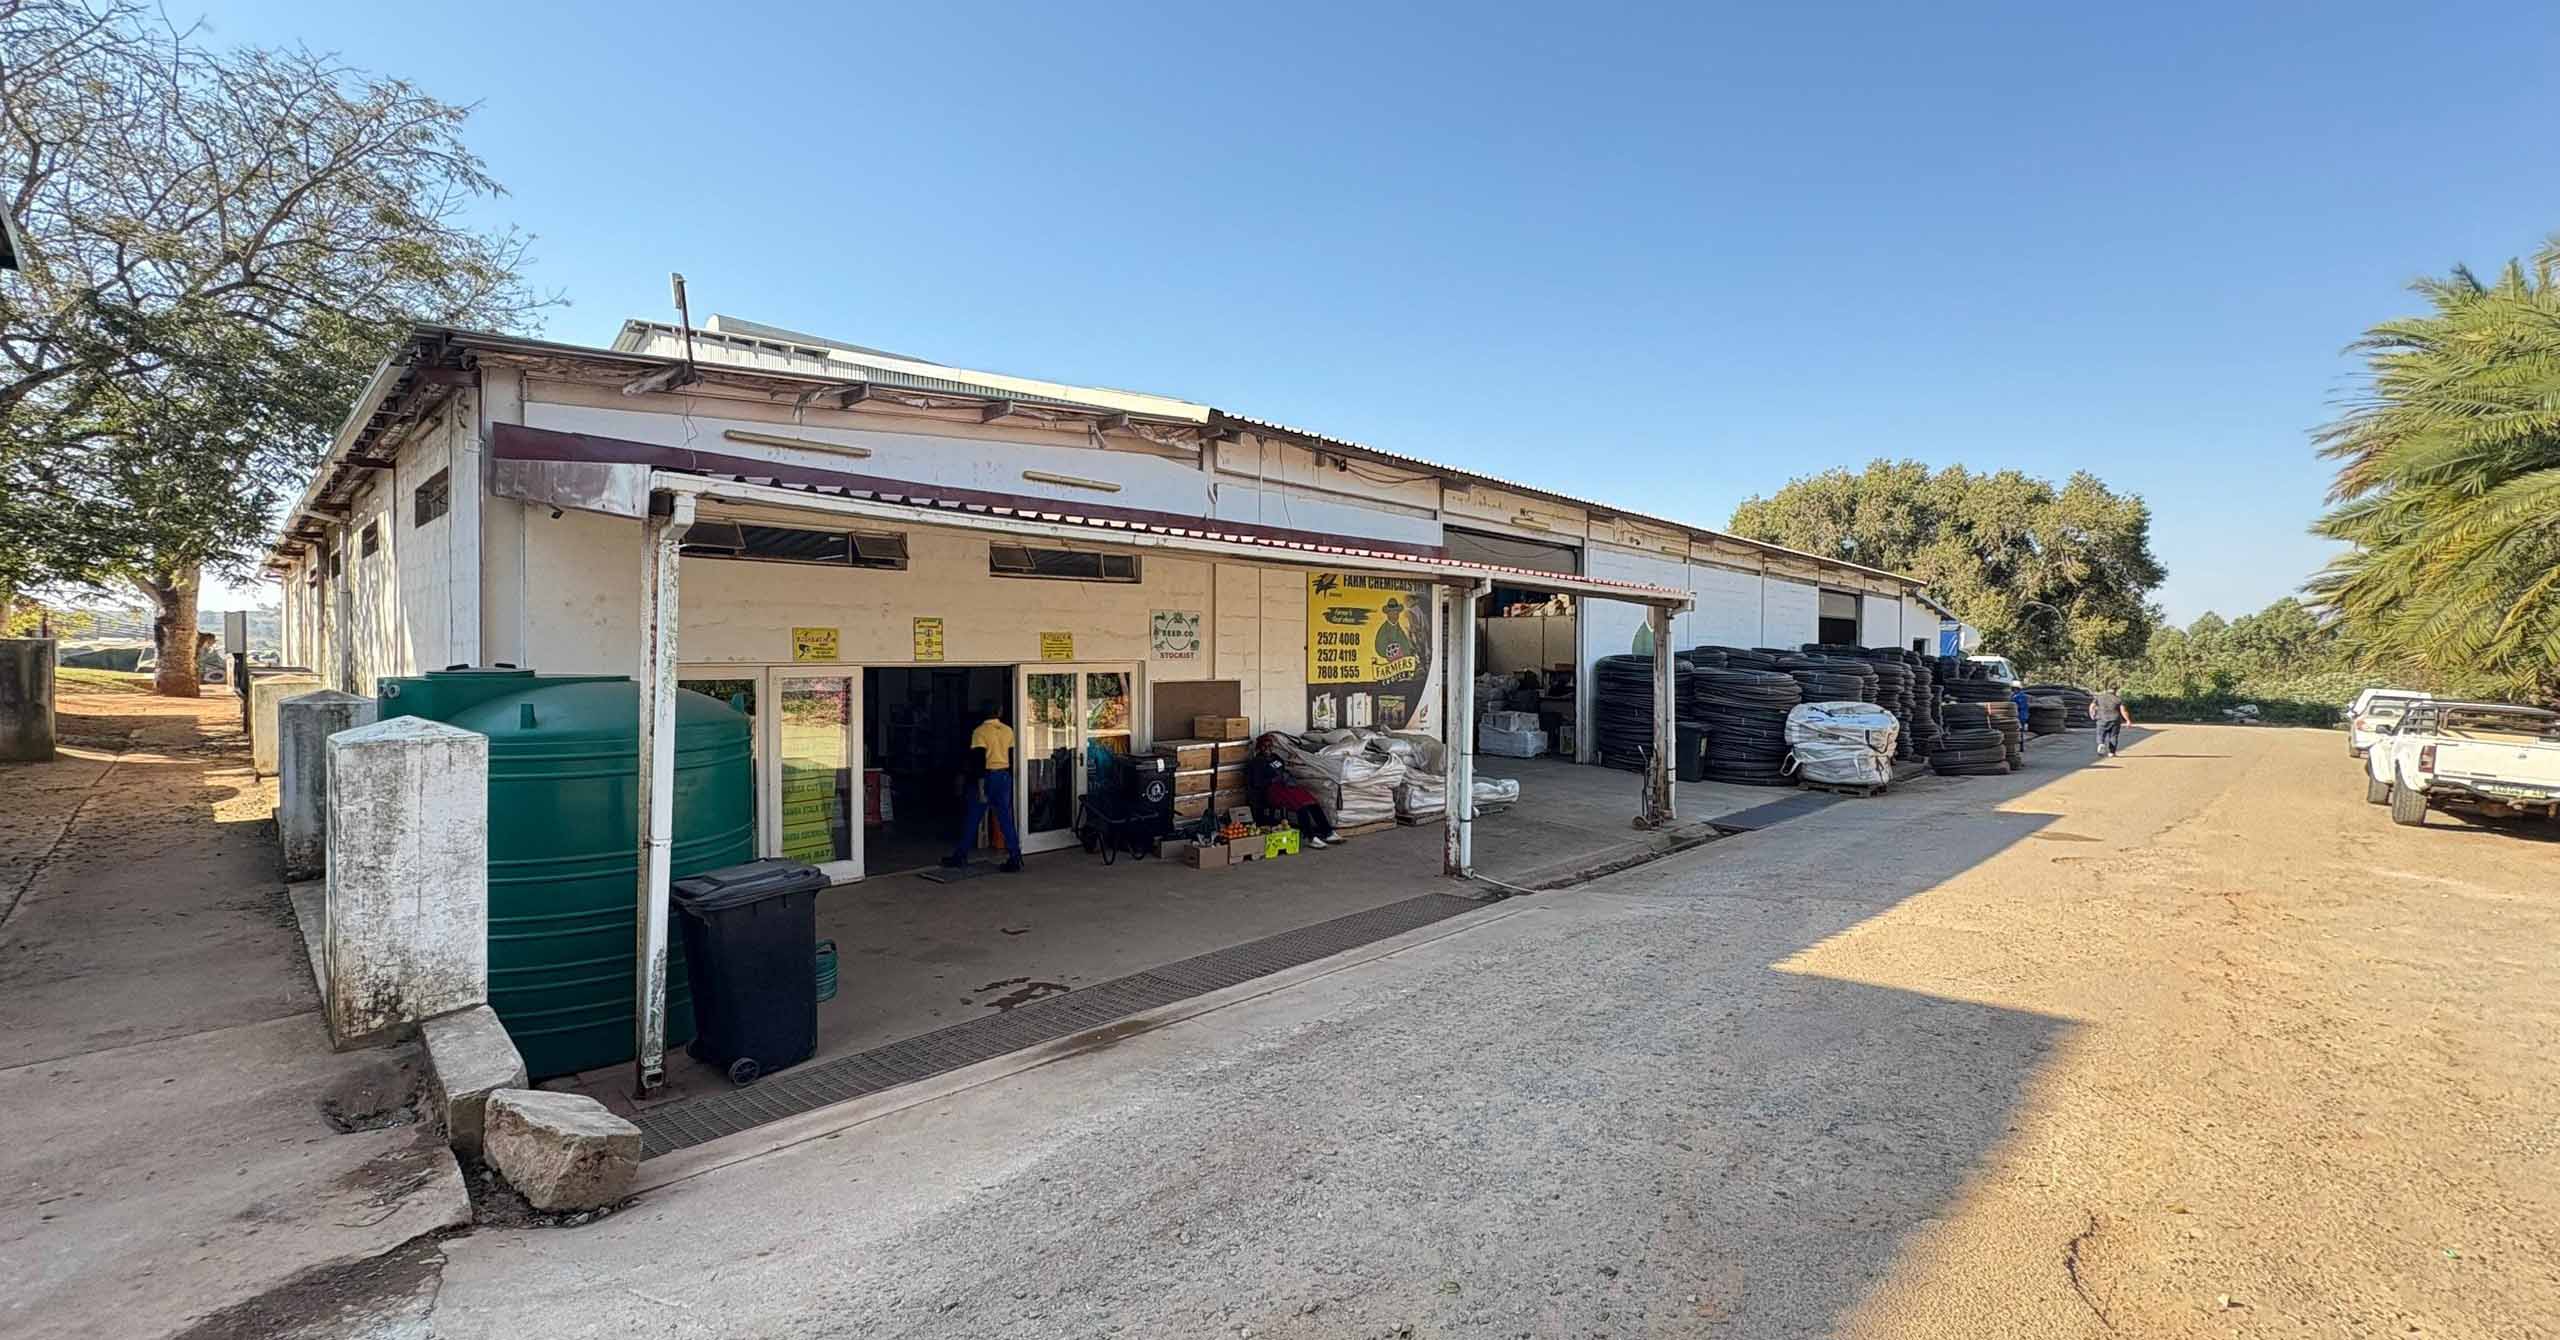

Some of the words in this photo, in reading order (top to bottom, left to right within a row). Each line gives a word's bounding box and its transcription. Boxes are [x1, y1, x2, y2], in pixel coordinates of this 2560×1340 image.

[1343, 575, 1367, 589] FARM
[1317, 632, 1338, 645] 2527
[1339, 633, 1360, 645] 4008
[1317, 649, 1338, 661] 2527
[1339, 649, 1358, 662] 4119
[1317, 666, 1338, 679] 7808
[1340, 666, 1360, 679] 1555
[1376, 658, 1413, 677] FARMERS
